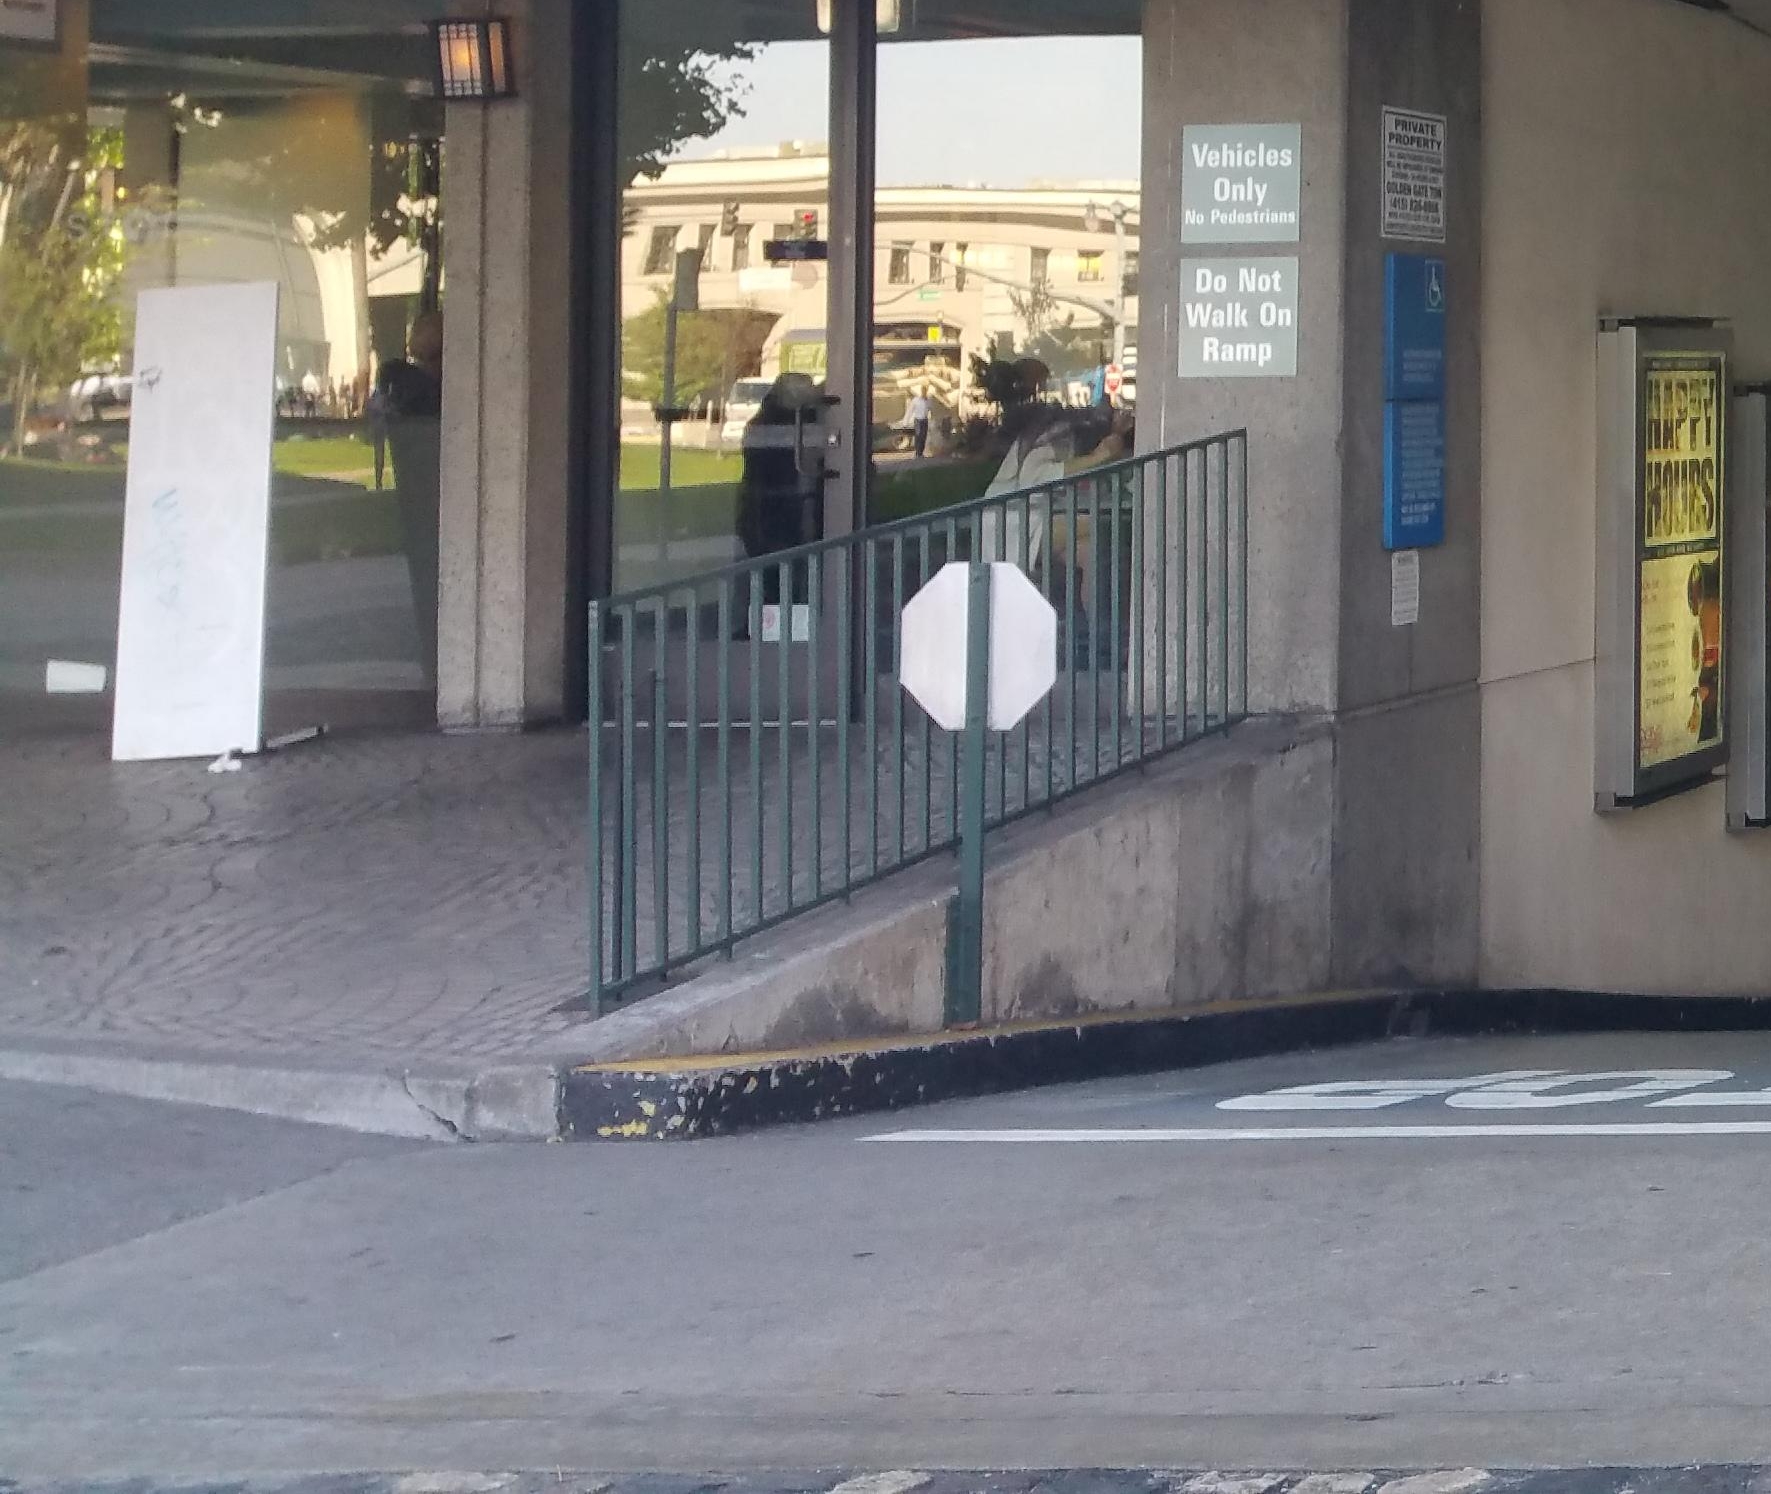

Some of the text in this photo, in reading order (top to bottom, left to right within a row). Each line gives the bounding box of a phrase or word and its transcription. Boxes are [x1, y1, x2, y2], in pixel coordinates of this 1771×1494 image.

[1394, 118, 1438, 136] PRIVATE
[1191, 142, 1293, 168] Vehicles
[1388, 132, 1442, 151] PROPERTY
[1213, 177, 1268, 206] Only
[1184, 208, 1296, 225] No Pedestrians
[1195, 267, 1282, 294] Do Not
[1185, 301, 1292, 328] Walk On
[1202, 336, 1273, 367] Ramp
[1647, 378, 1715, 451] HAPPY
[1646, 458, 1715, 539] HOURS
